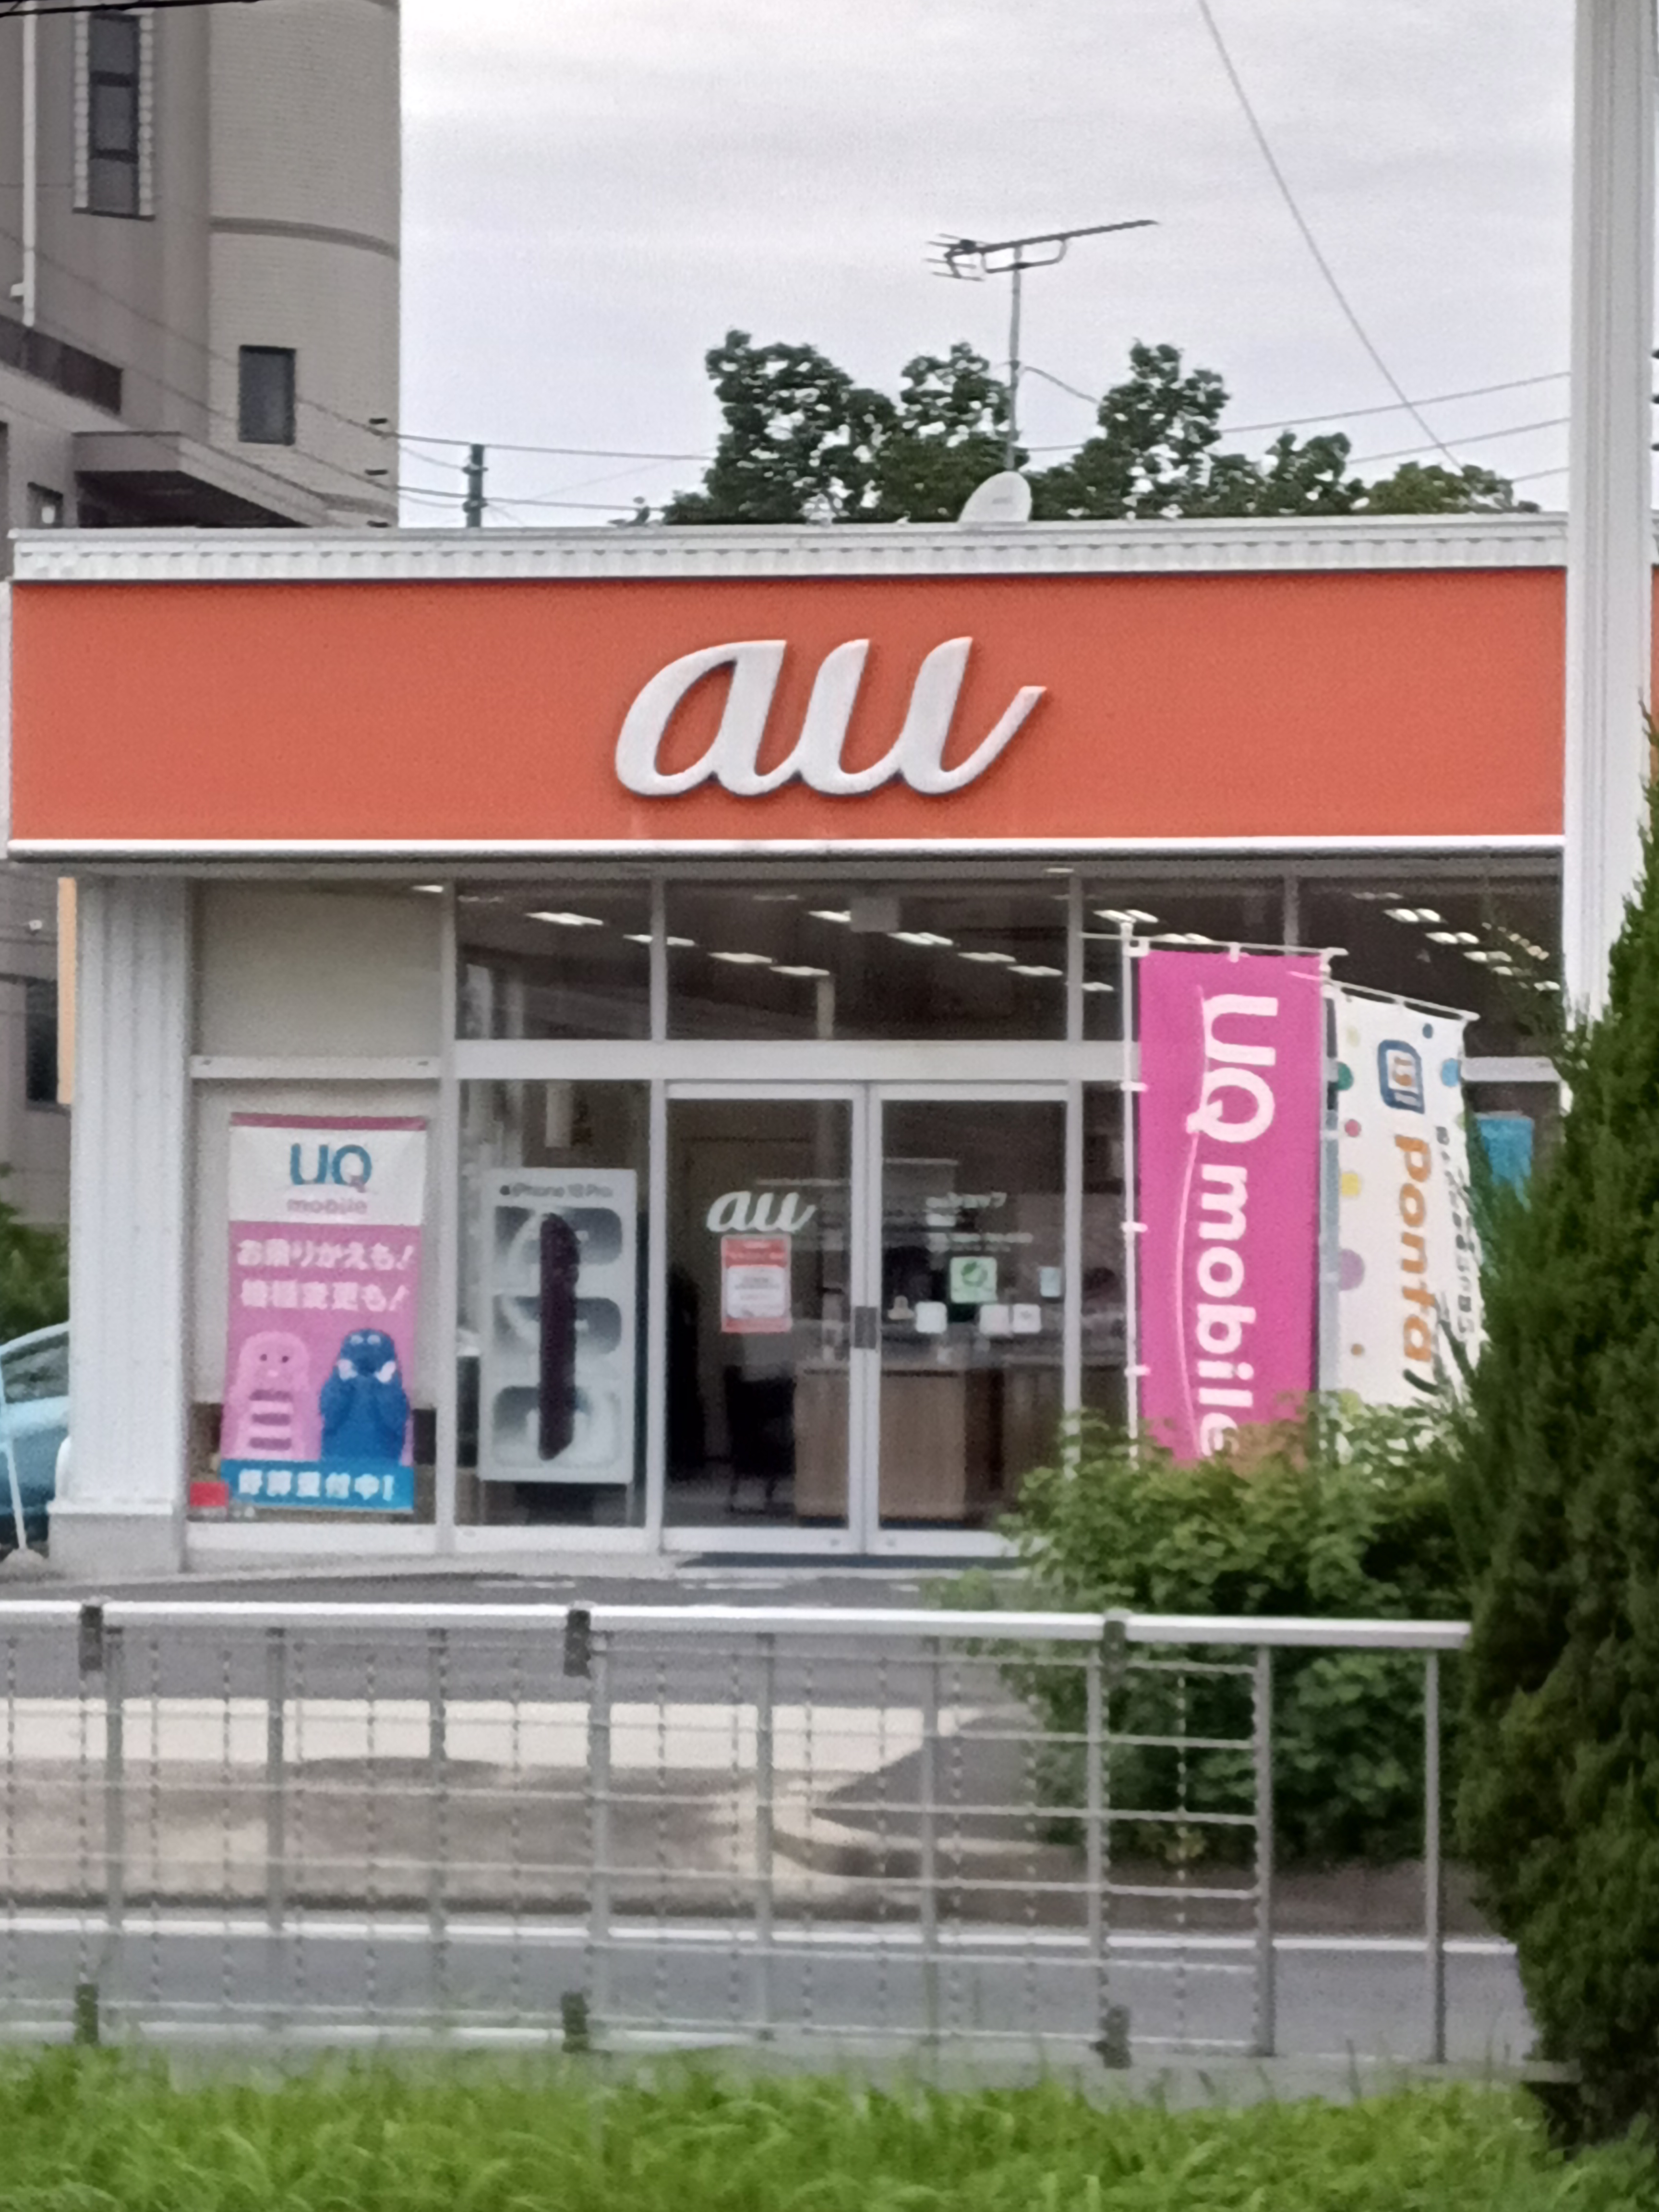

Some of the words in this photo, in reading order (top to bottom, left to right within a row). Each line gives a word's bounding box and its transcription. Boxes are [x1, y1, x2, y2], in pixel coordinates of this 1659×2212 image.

[615, 636, 1047, 796] au
[1187, 993, 1278, 1143] UQ
[290, 1142, 373, 1193] UQ
[706, 1190, 816, 1233] au
[1196, 1164, 1256, 1456] mobile
